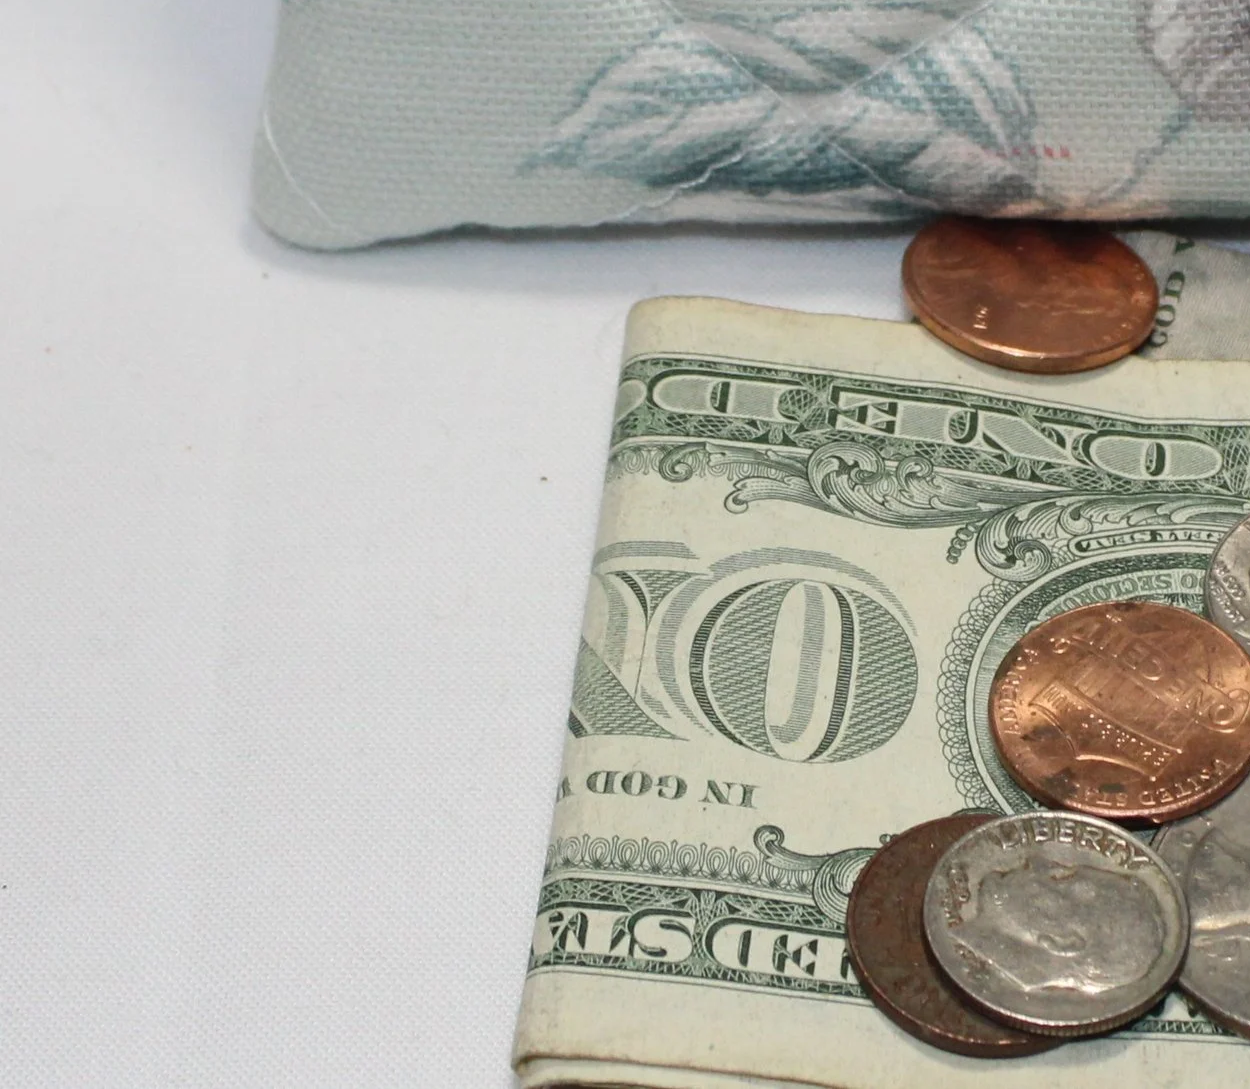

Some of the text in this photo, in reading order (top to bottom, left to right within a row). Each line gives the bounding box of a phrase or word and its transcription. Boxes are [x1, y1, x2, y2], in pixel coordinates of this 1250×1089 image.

[828, 386, 1222, 481] ONE
[586, 770, 688, 801] GOD
[700, 779, 759, 810] IN
[1139, 758, 1232, 806] UNITED
[991, 820, 1151, 870] LIBERTY
